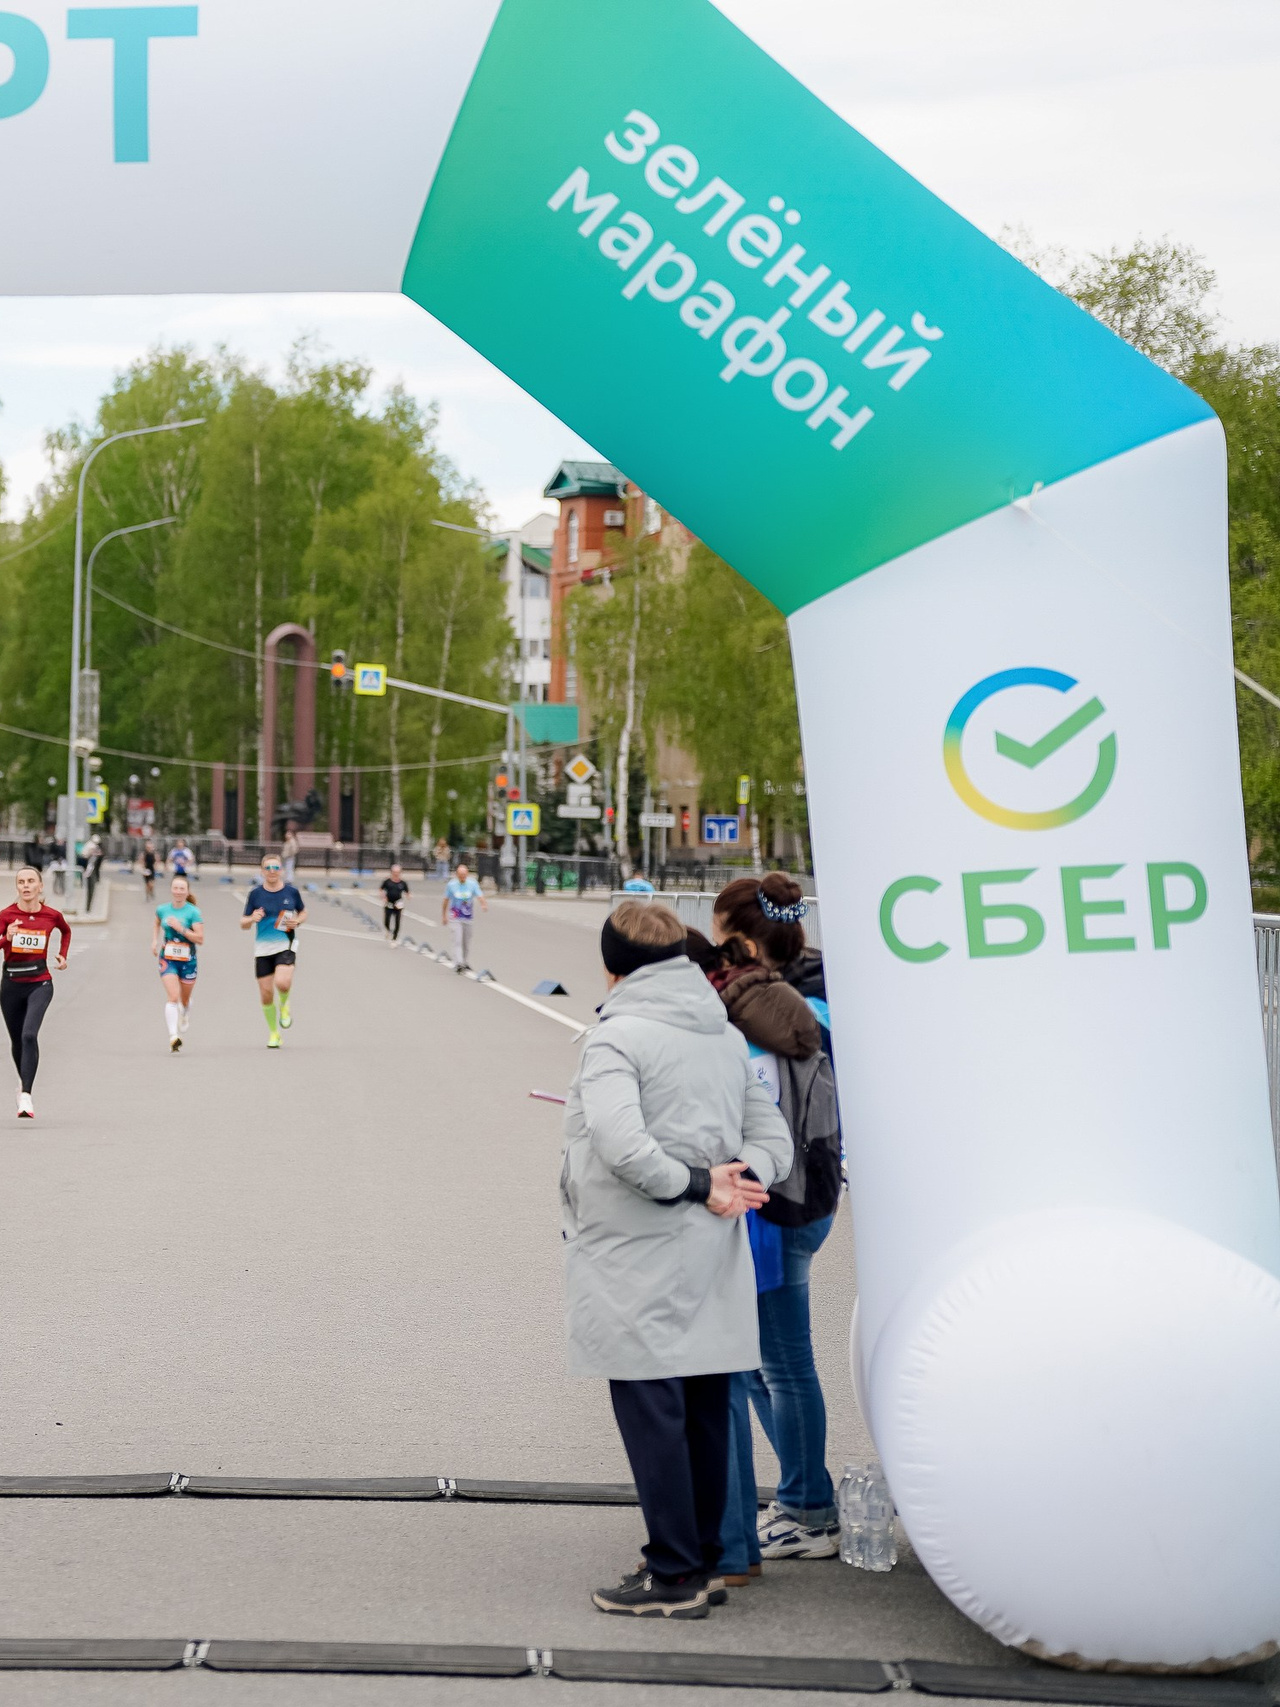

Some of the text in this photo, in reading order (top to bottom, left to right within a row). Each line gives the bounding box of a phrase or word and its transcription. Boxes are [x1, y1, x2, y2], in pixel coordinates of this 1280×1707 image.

[547, 166, 876, 451] марафон
[604, 109, 944, 391] зелёный
[20, 936, 39, 947] 303
[879, 861, 1209, 964] СБЕР
